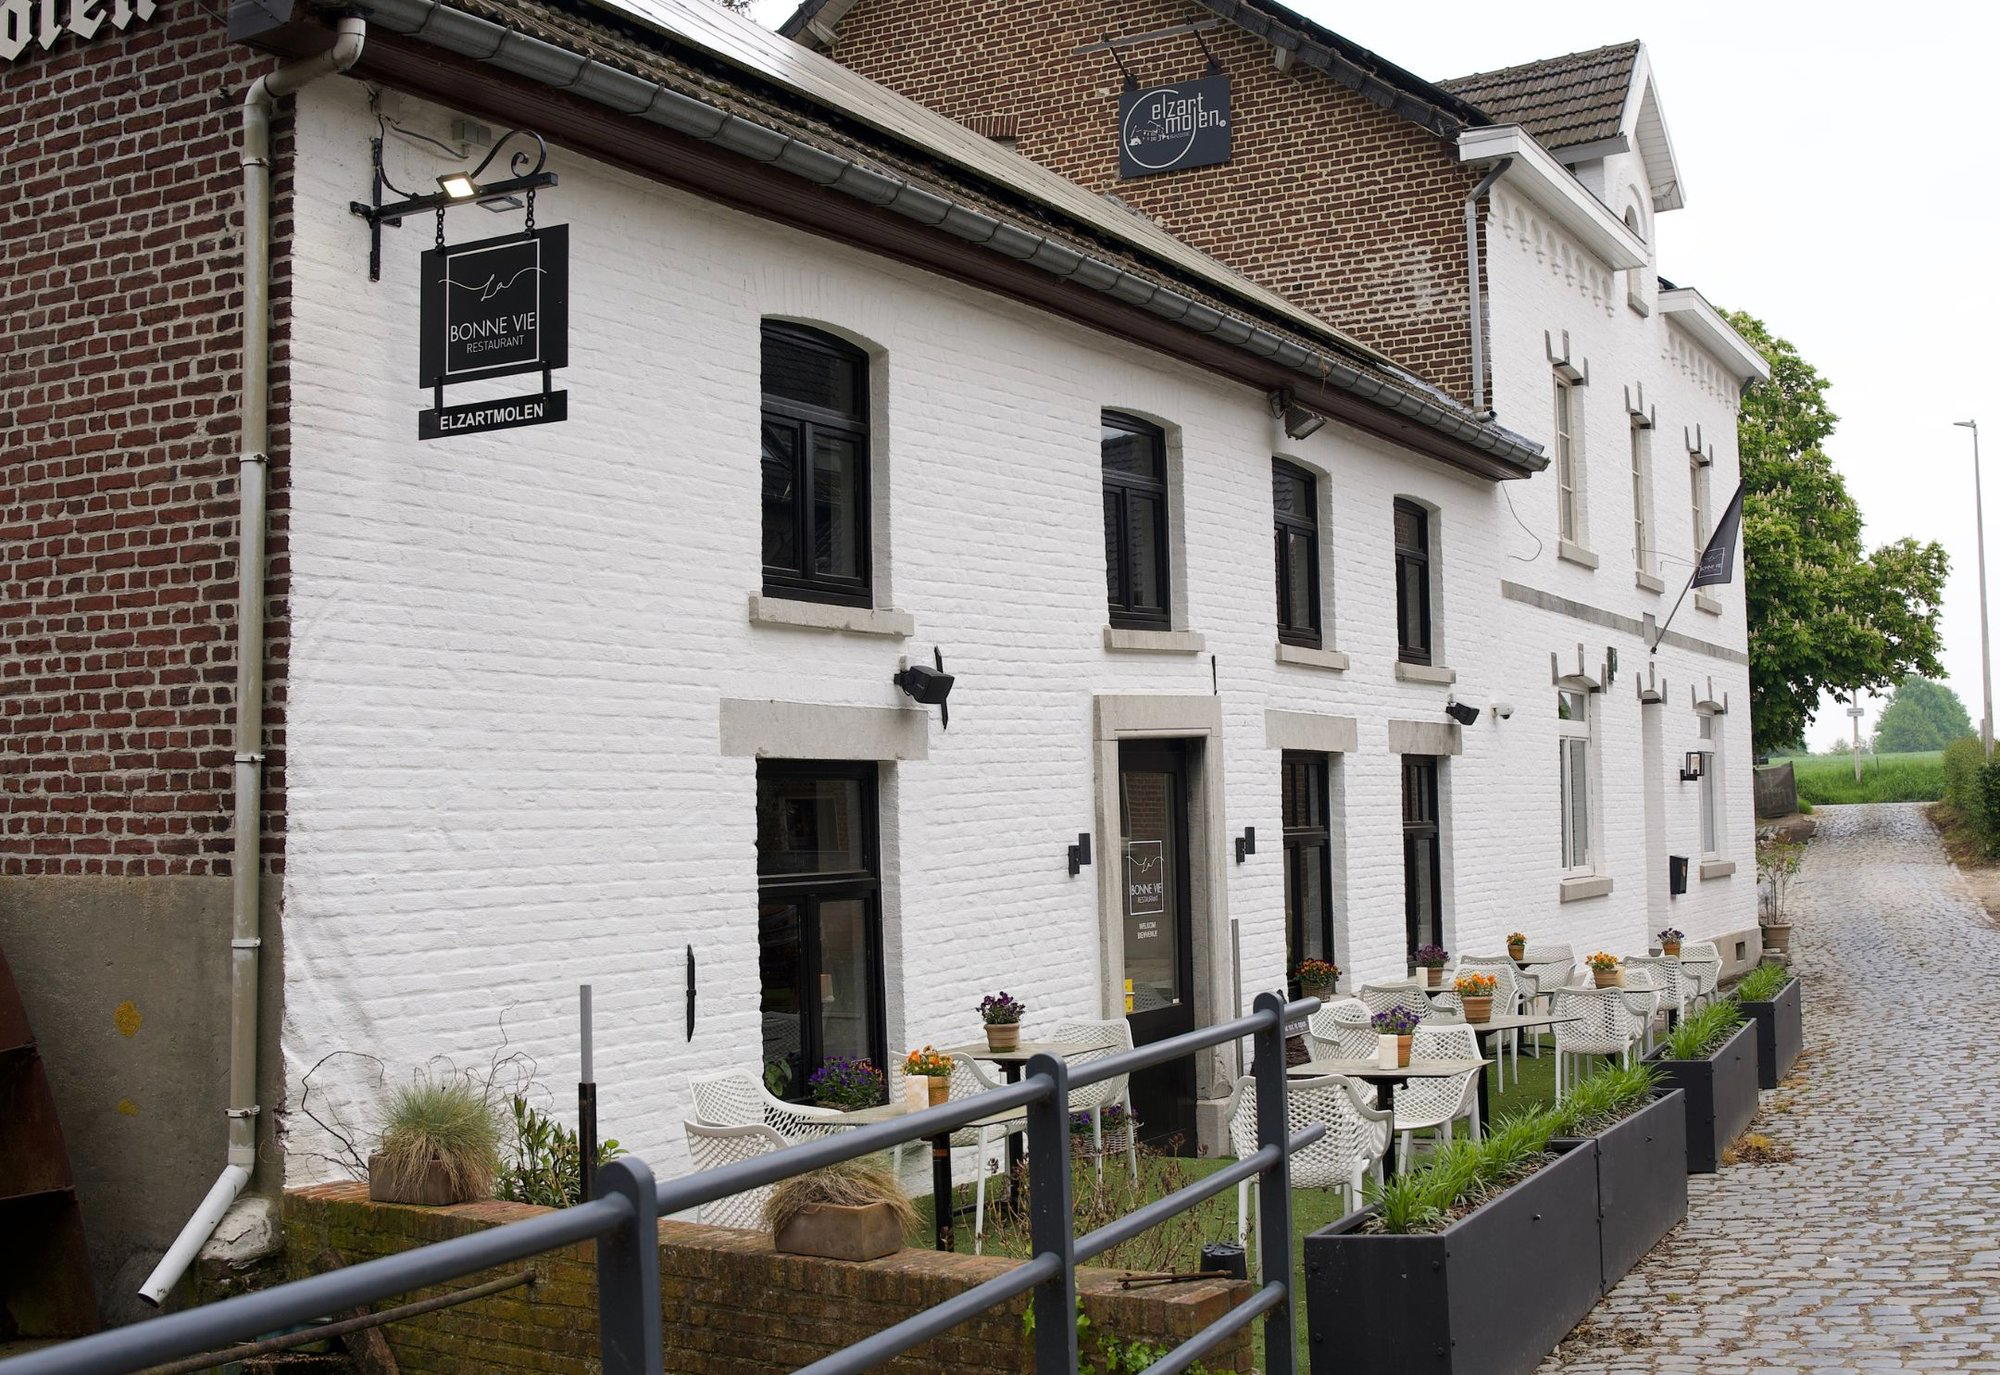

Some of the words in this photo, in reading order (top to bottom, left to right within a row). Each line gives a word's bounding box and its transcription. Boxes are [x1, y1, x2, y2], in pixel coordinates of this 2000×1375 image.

[1152, 92, 1203, 120] elzart
[450, 316, 508, 342] BONNE
[512, 312, 536, 333] VIE
[466, 335, 525, 354] RESTAURANT
[440, 402, 544, 431] ELZARTMOLEN
[1131, 883, 1152, 896] BONNE
